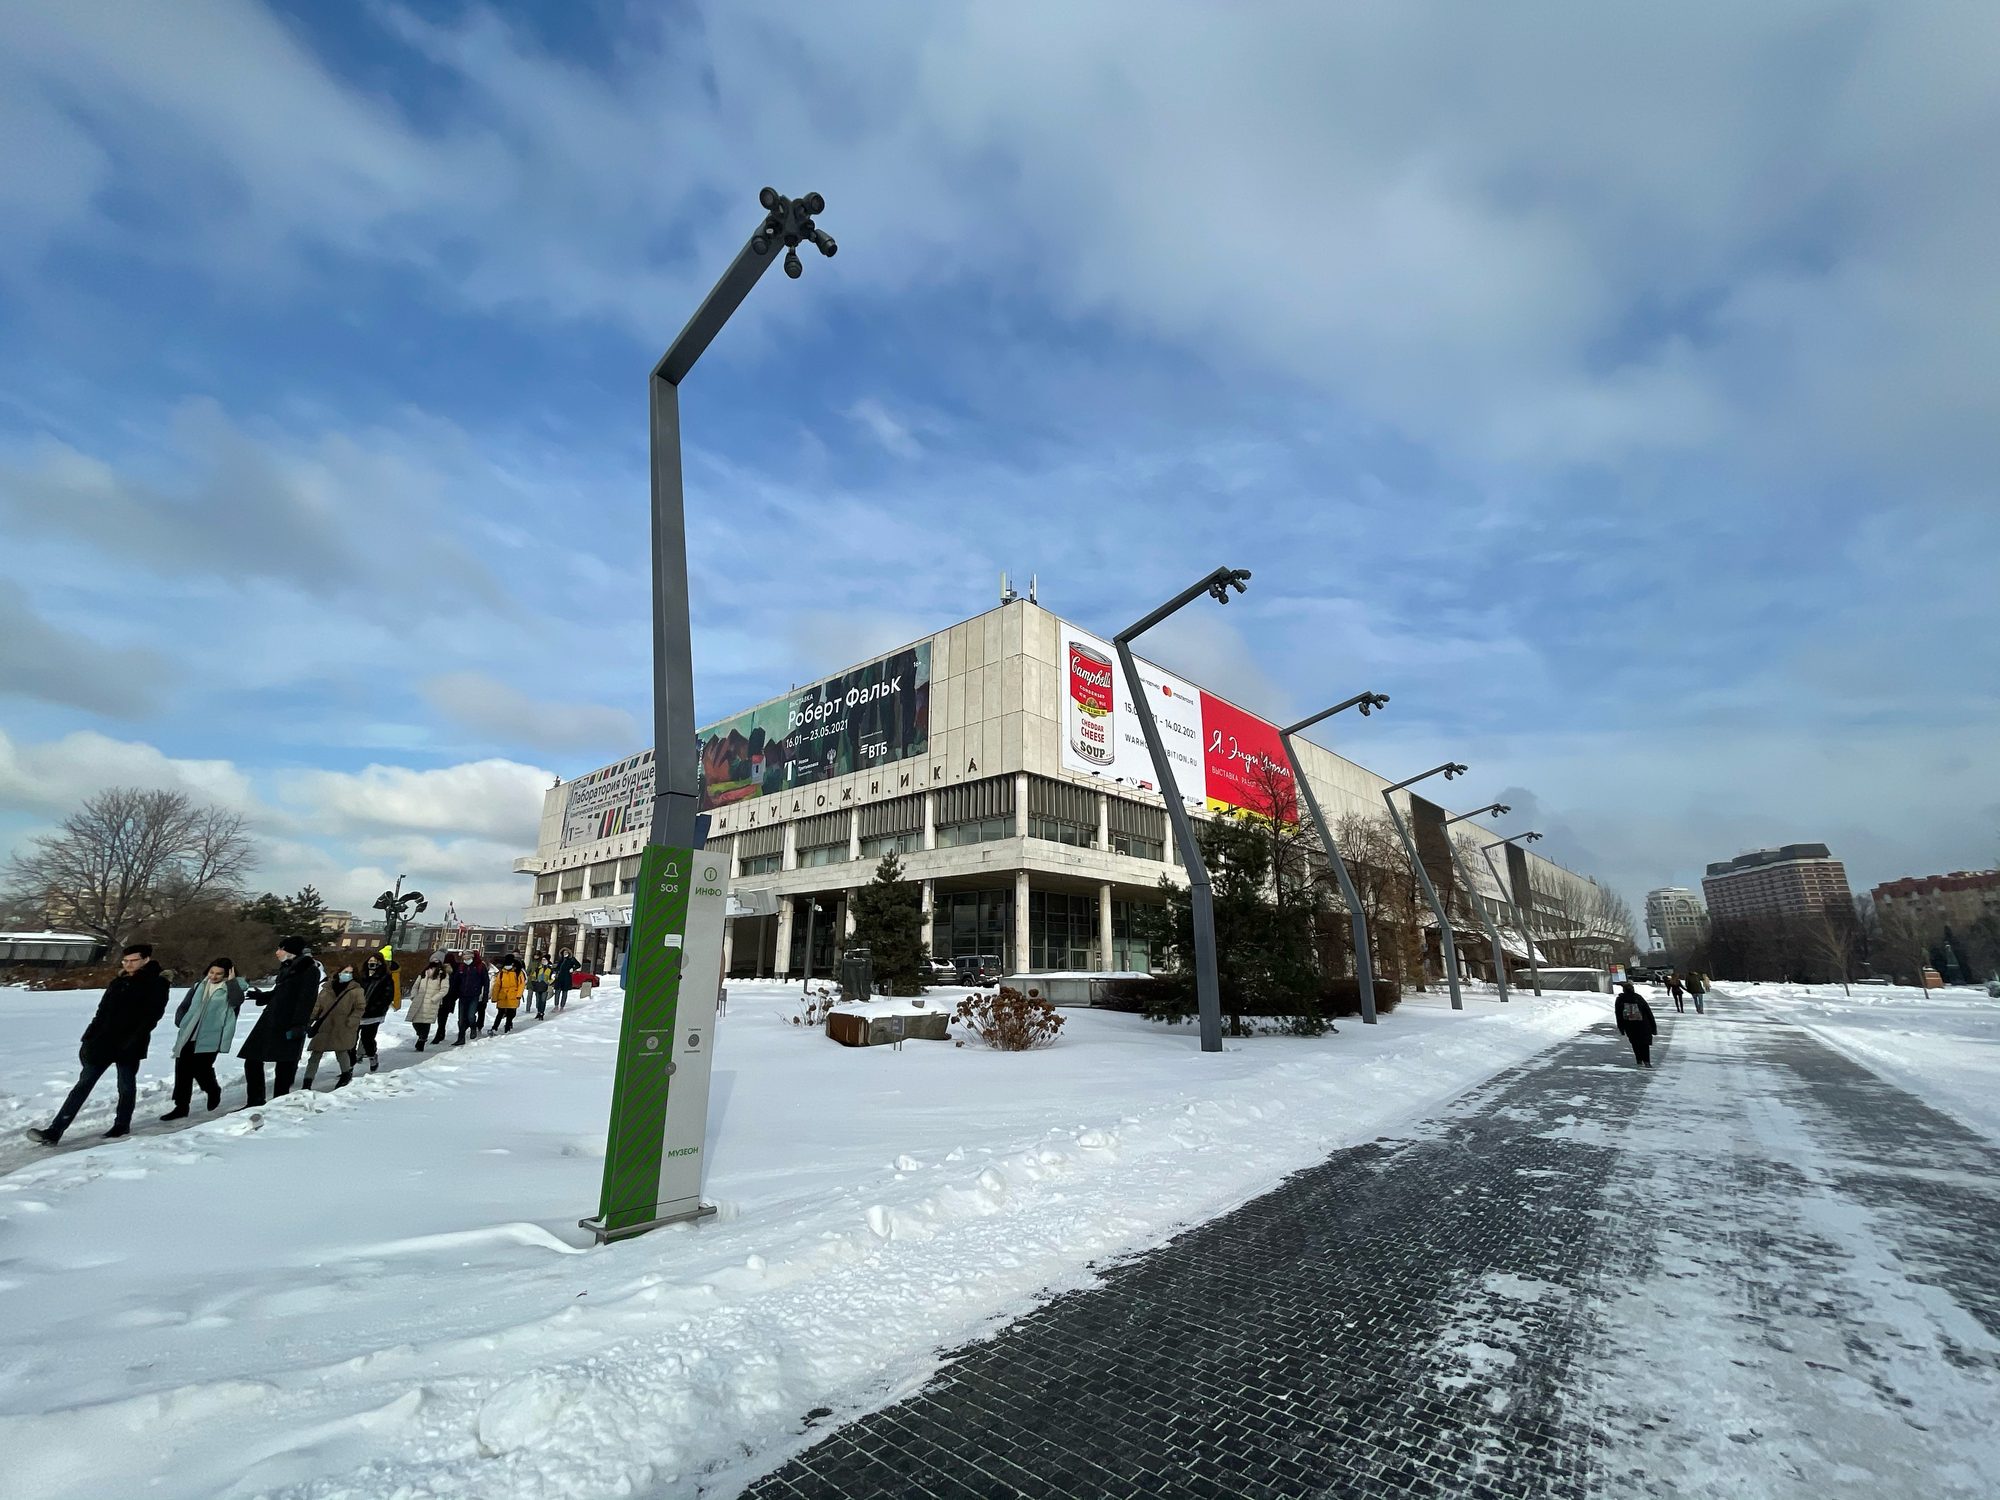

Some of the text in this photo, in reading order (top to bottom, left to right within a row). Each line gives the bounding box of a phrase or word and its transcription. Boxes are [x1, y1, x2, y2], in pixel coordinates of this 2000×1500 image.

[788, 675, 902, 730] Роберт Фальк
[1081, 718, 1105, 732] CHEDDAR
[1165, 719, 1196, 739] 14.02.2021
[1080, 726, 1105, 744] CHEESE
[868, 741, 888, 759] ВТБ
[1079, 740, 1106, 758] SOUP
[1211, 766, 1239, 782] ВЫСТАВКА
[572, 780, 620, 805] Лаборатория
[621, 766, 655, 793] будуще
[660, 883, 679, 893] SOS
[695, 886, 722, 897] ИНФО
[667, 1146, 699, 1158] МУЗЕОН
